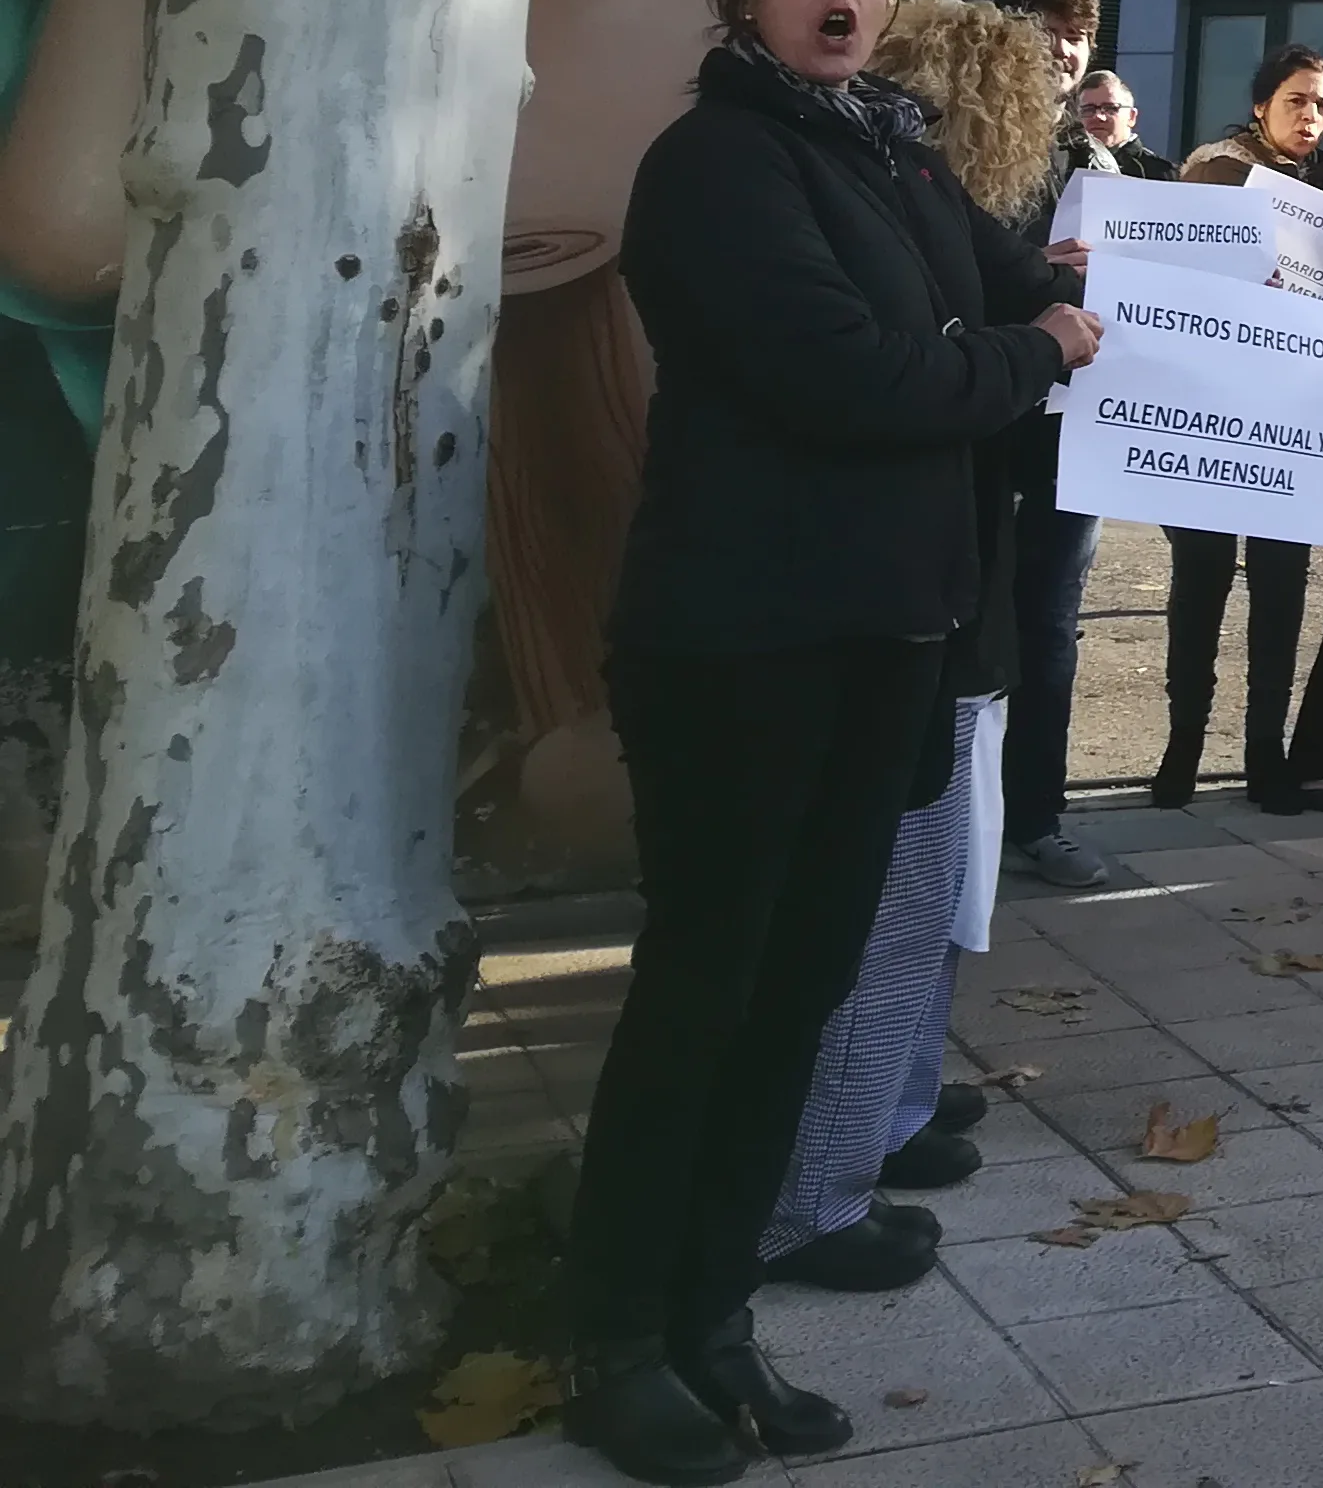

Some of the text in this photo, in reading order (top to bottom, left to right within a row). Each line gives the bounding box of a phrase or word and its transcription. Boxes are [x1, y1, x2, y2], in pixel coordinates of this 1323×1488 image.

[1104, 219, 1262, 245] NUESTROS DERECHOS:
[1117, 301, 1231, 341] NUESTROS
[1098, 397, 1244, 438] CALENDARIO
[1248, 423, 1314, 451] ANUAL
[1126, 446, 1295, 491] PAGA MENSUAL
